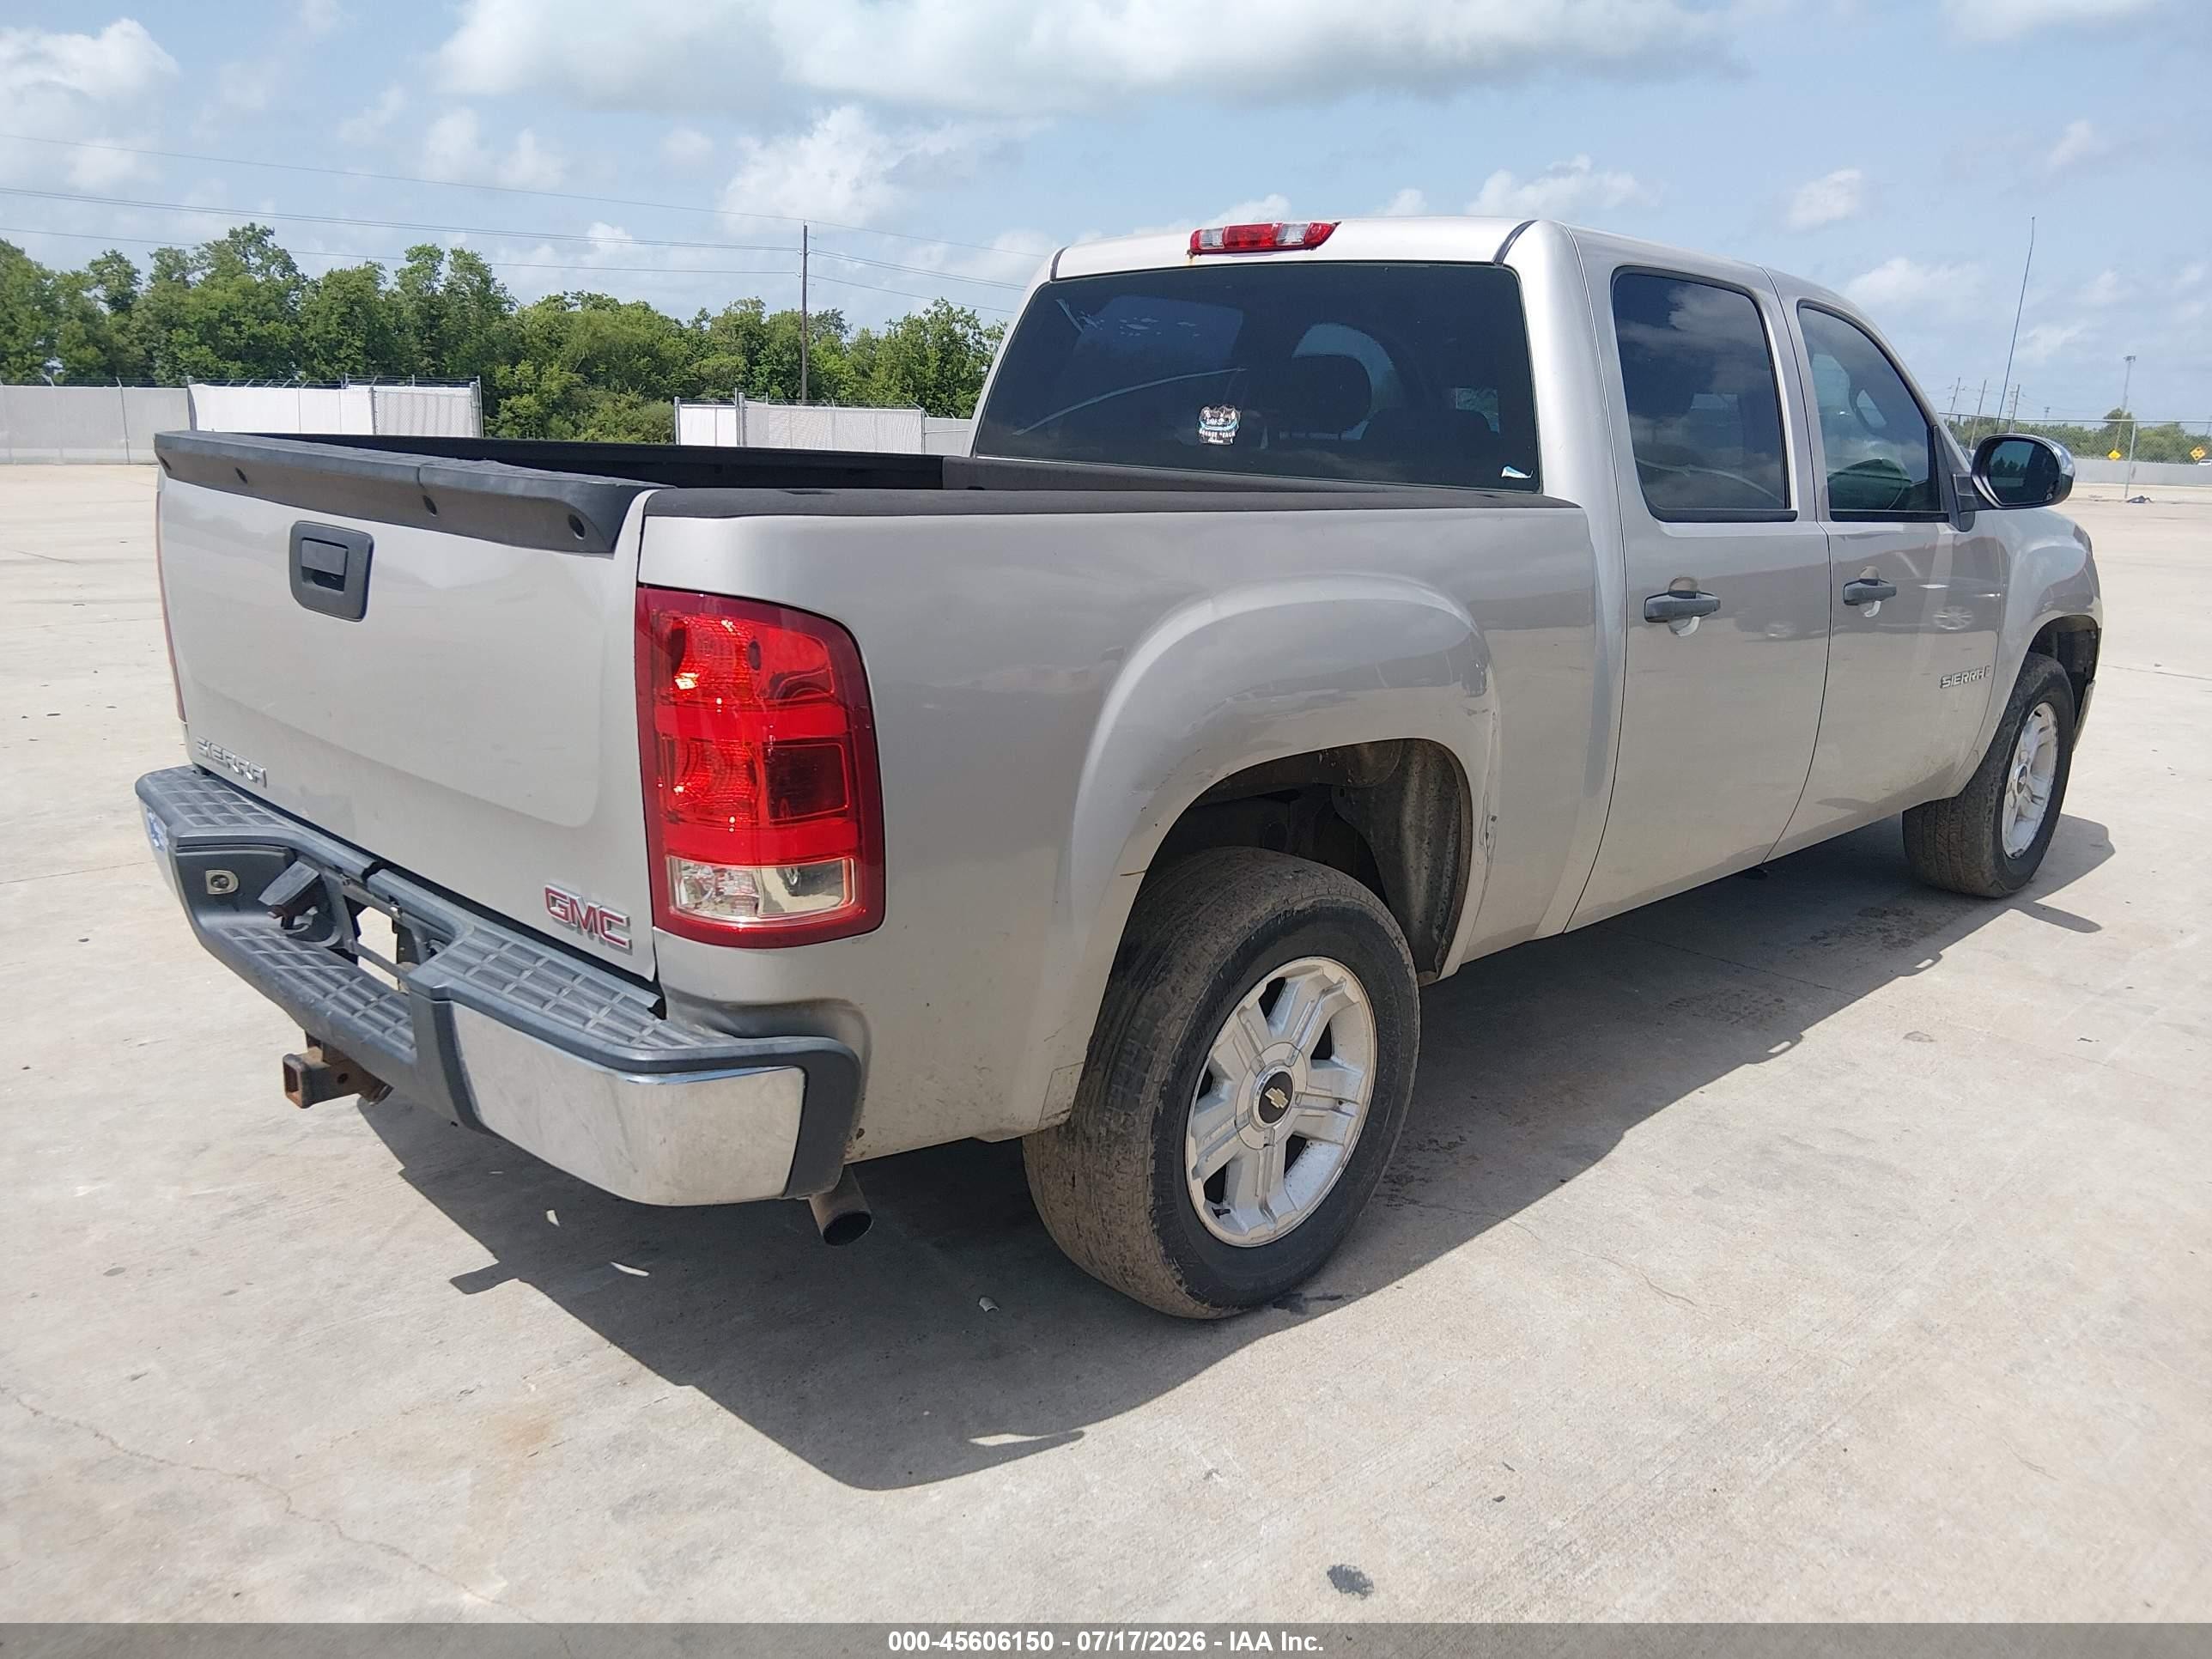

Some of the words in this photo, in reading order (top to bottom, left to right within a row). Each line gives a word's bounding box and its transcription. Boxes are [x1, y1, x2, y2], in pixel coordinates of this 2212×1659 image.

[1940, 665, 1990, 689] SIERRA
[197, 737, 268, 789] SIERRA
[544, 884, 633, 951] GMC
